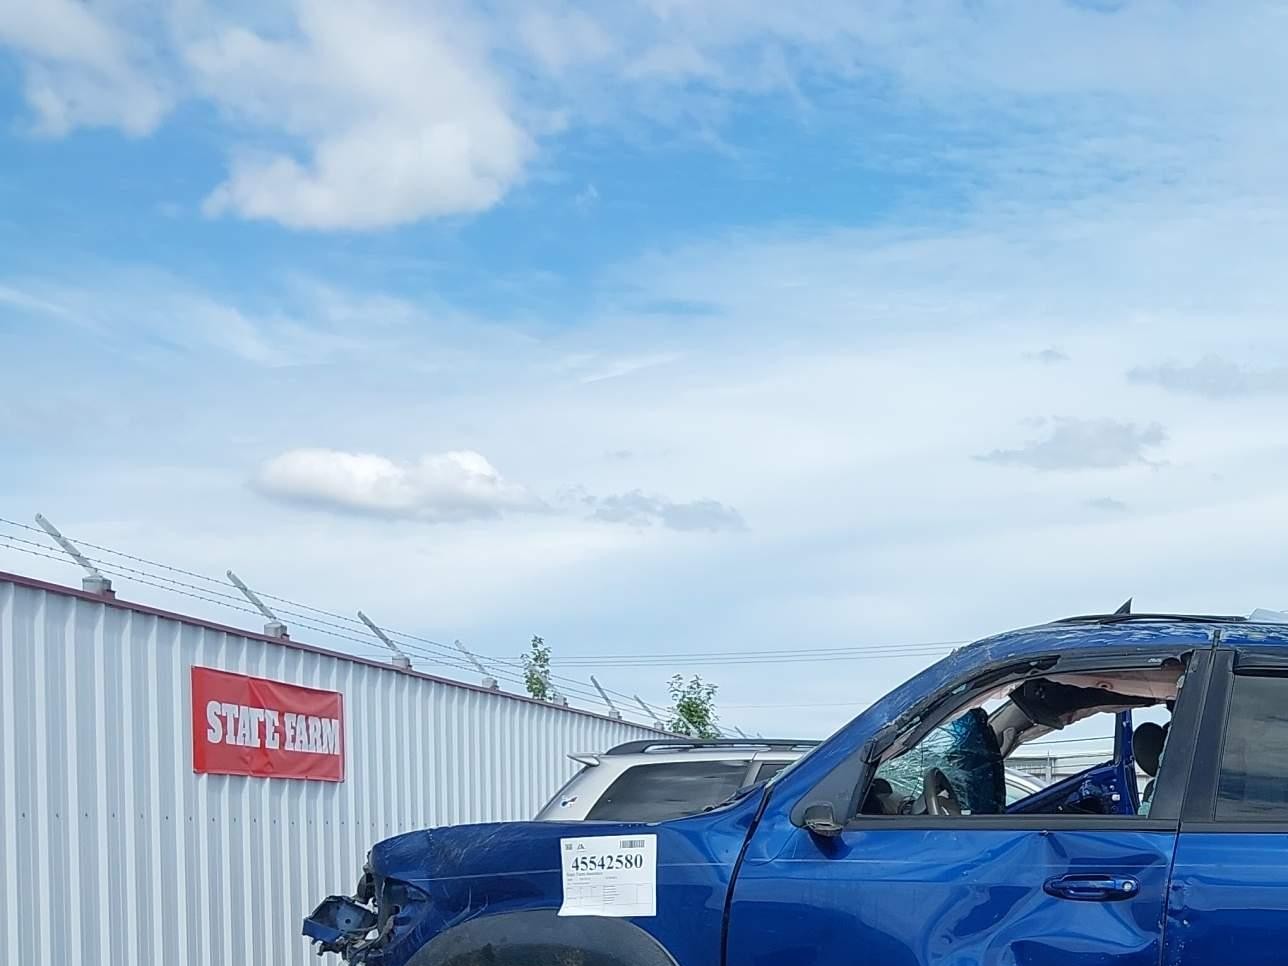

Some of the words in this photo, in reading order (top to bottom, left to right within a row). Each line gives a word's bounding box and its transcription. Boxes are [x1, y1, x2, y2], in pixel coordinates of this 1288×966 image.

[206, 700, 279, 750] STATE
[284, 713, 340, 755] FARM
[571, 854, 643, 871] 45542580
